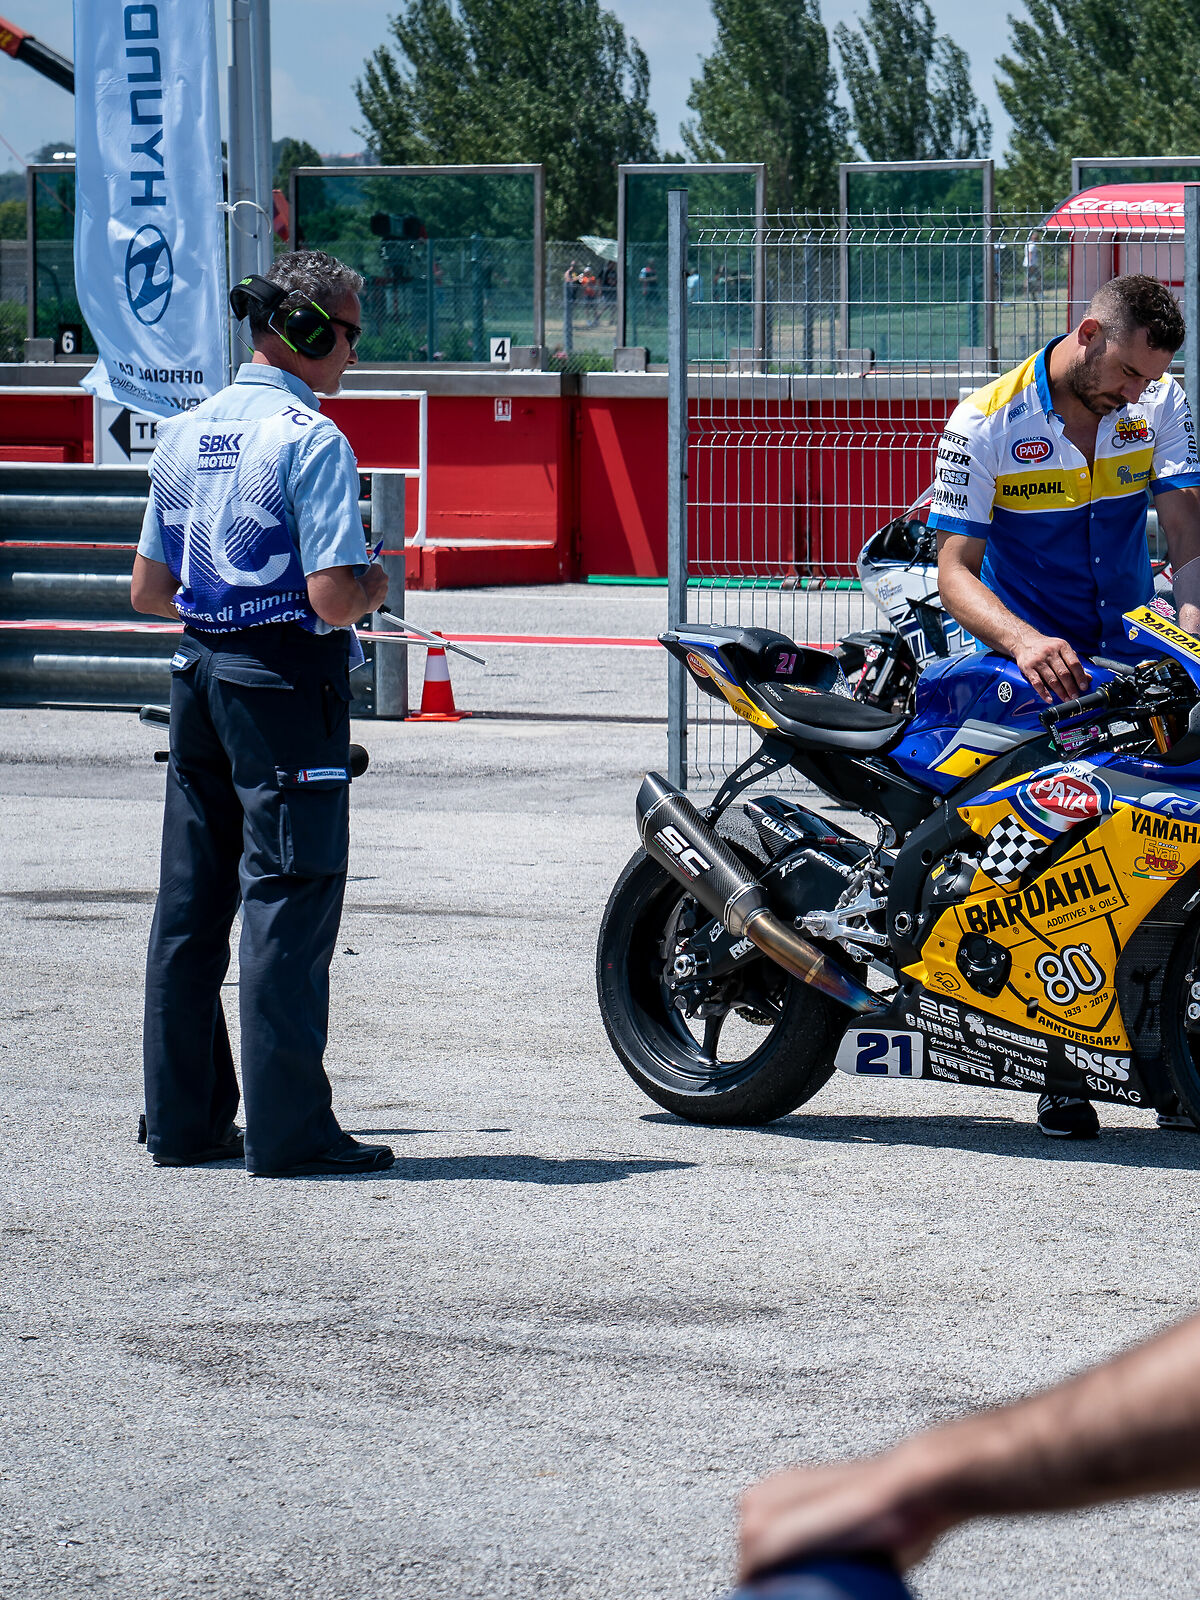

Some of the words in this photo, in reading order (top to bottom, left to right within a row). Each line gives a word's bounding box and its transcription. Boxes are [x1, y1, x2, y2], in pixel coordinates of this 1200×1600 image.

[62, 331, 74, 353] 6
[306, 325, 325, 344] uvex
[494, 340, 507, 361] 4
[281, 405, 313, 427] TC
[1115, 418, 1148, 432] Evan
[199, 455, 238, 469] MOTUL
[1019, 444, 1045, 456] PATA
[1003, 482, 1065, 500] BARDAHL
[163, 500, 291, 589] TC
[217, 605, 233, 623] di
[775, 652, 797, 674] 21
[1034, 778, 1090, 814] PATA
[656, 825, 711, 877] SC
[1143, 838, 1180, 861] Evan
[965, 863, 1111, 948] BARDAHL
[1047, 907, 1087, 928] ADDITIVES
[1089, 904, 1096, 913] &
[1098, 896, 1118, 909] OILS
[1063, 1005, 1082, 1018] 1939
[1089, 992, 1109, 1008] 2019
[905, 1013, 966, 1043] GAIRSA
[986, 1024, 1048, 1049] SOPREMA
[1038, 1015, 1121, 1046] ANNIVERSARY
[856, 1032, 912, 1076] 21
[928, 1049, 996, 1082] PIRELLI
[988, 1042, 1048, 1068] ROMPLAST
[1014, 1063, 1046, 1081] TITAN
